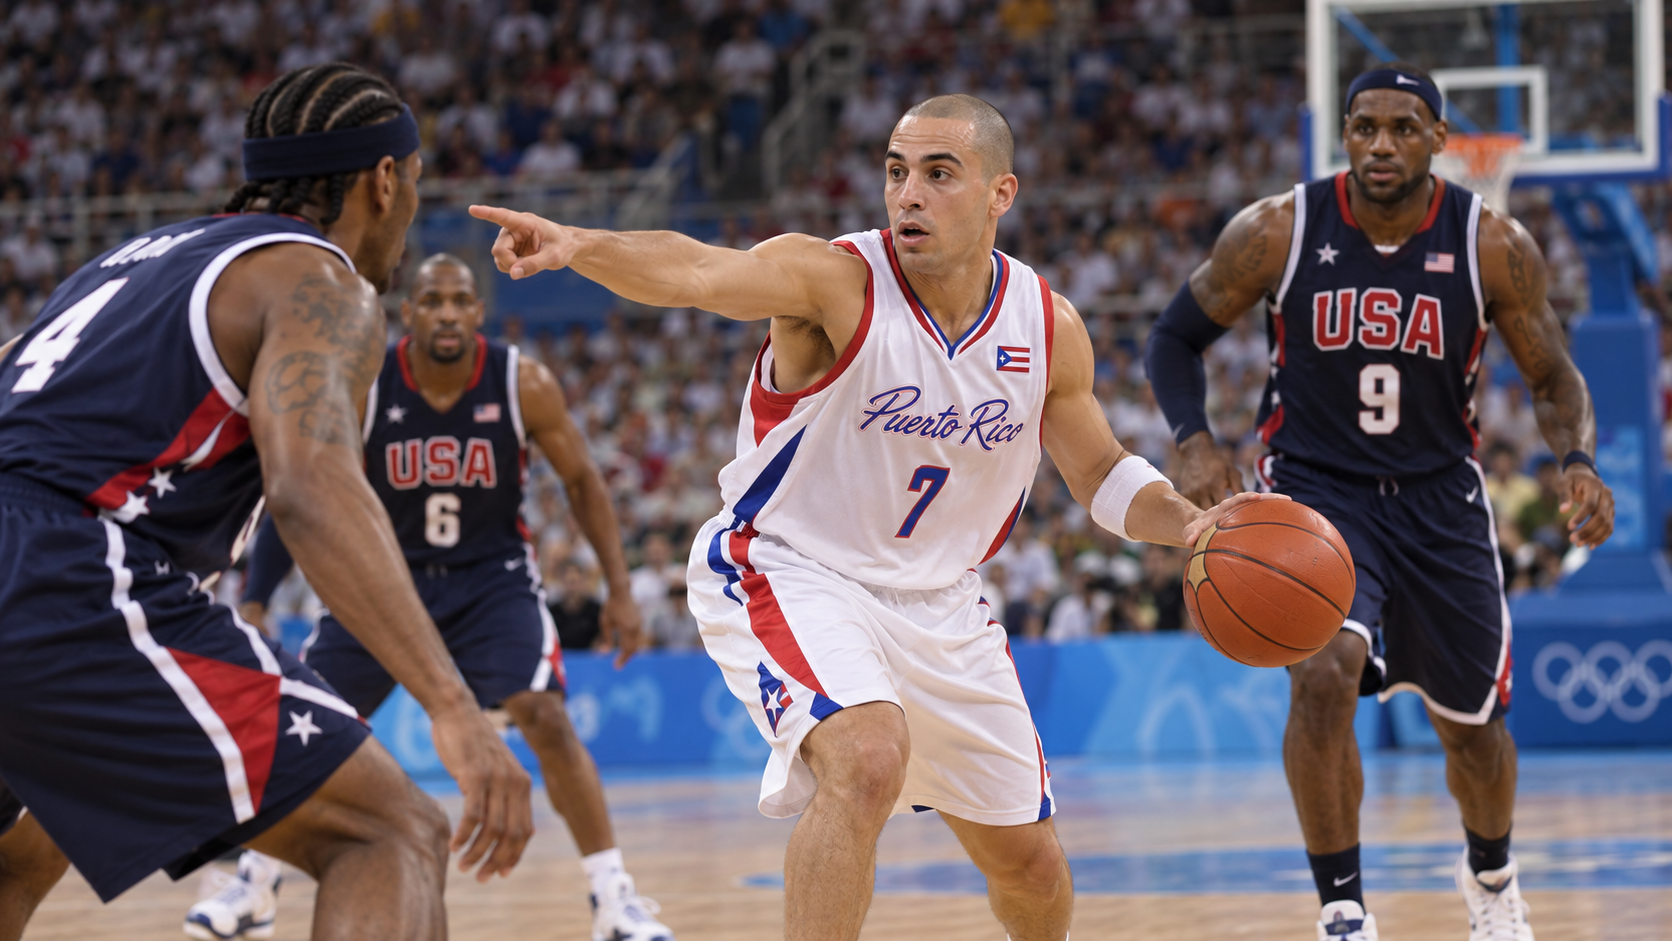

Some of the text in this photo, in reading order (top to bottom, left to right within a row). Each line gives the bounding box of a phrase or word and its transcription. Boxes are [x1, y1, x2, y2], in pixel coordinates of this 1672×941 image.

[11, 277, 129, 393] 4
[1313, 287, 1444, 360] USA
[858, 384, 1024, 453] Puerto Rico
[1358, 363, 1400, 434] 9
[385, 435, 498, 491] USA
[425, 492, 462, 548] 6
[894, 464, 951, 539] 7
